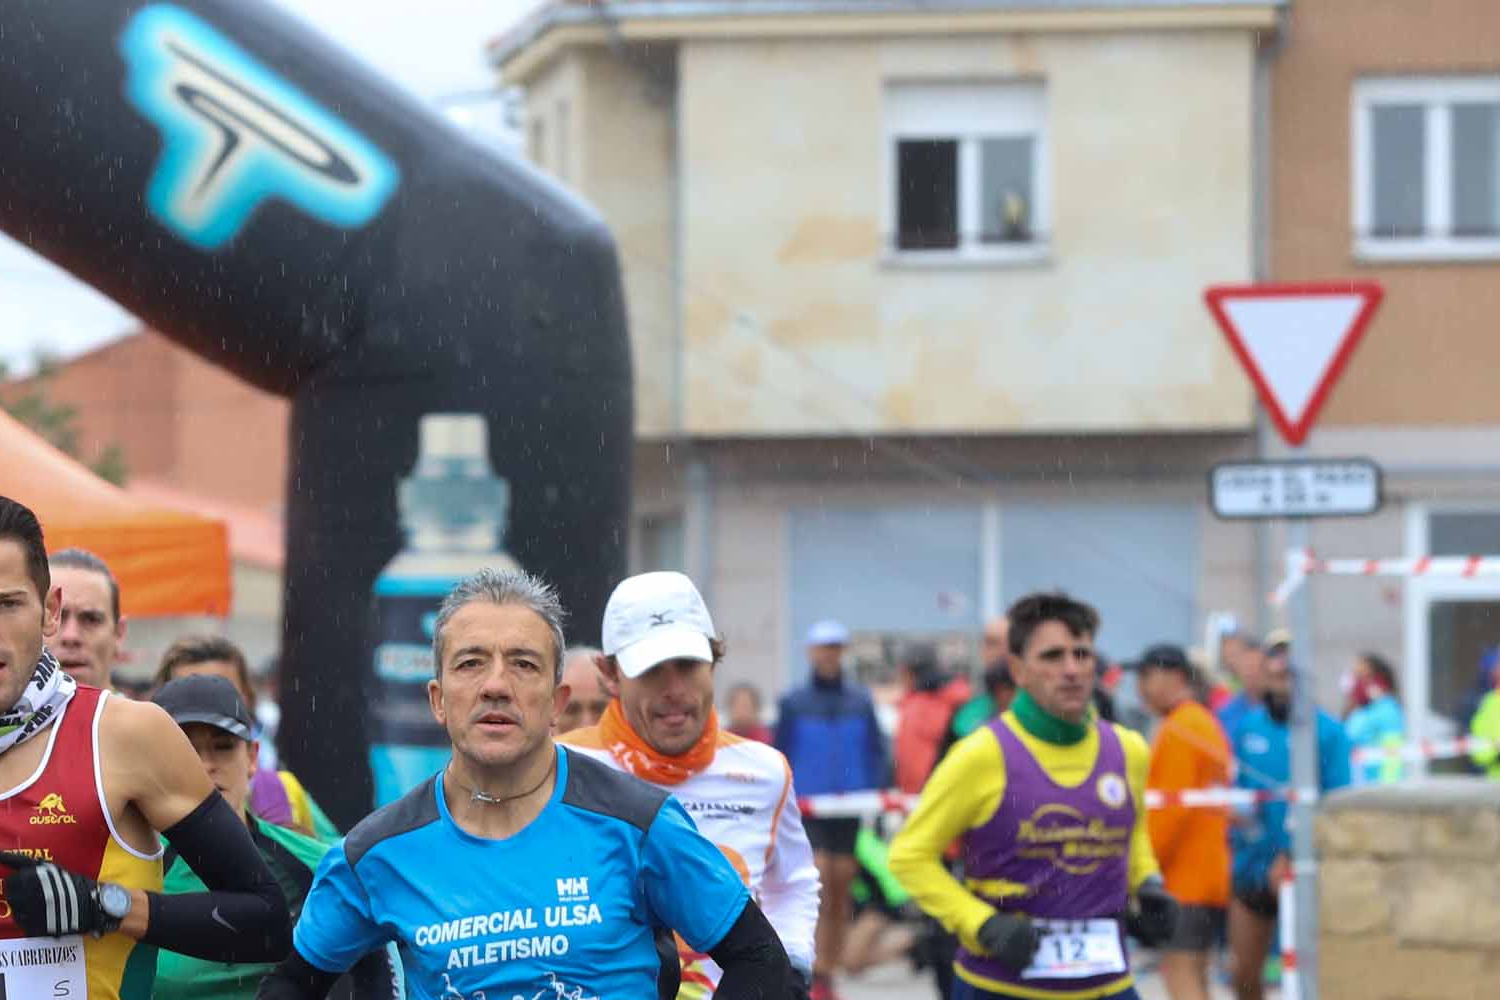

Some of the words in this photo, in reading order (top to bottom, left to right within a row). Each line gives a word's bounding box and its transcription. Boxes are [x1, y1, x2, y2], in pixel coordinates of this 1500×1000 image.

[415, 907, 538, 947] COMERCIAL
[544, 903, 603, 928] ULSA
[446, 934, 569, 970] ATLETISMO
[1052, 938, 1088, 961] 12
[53, 979, 71, 997] S
